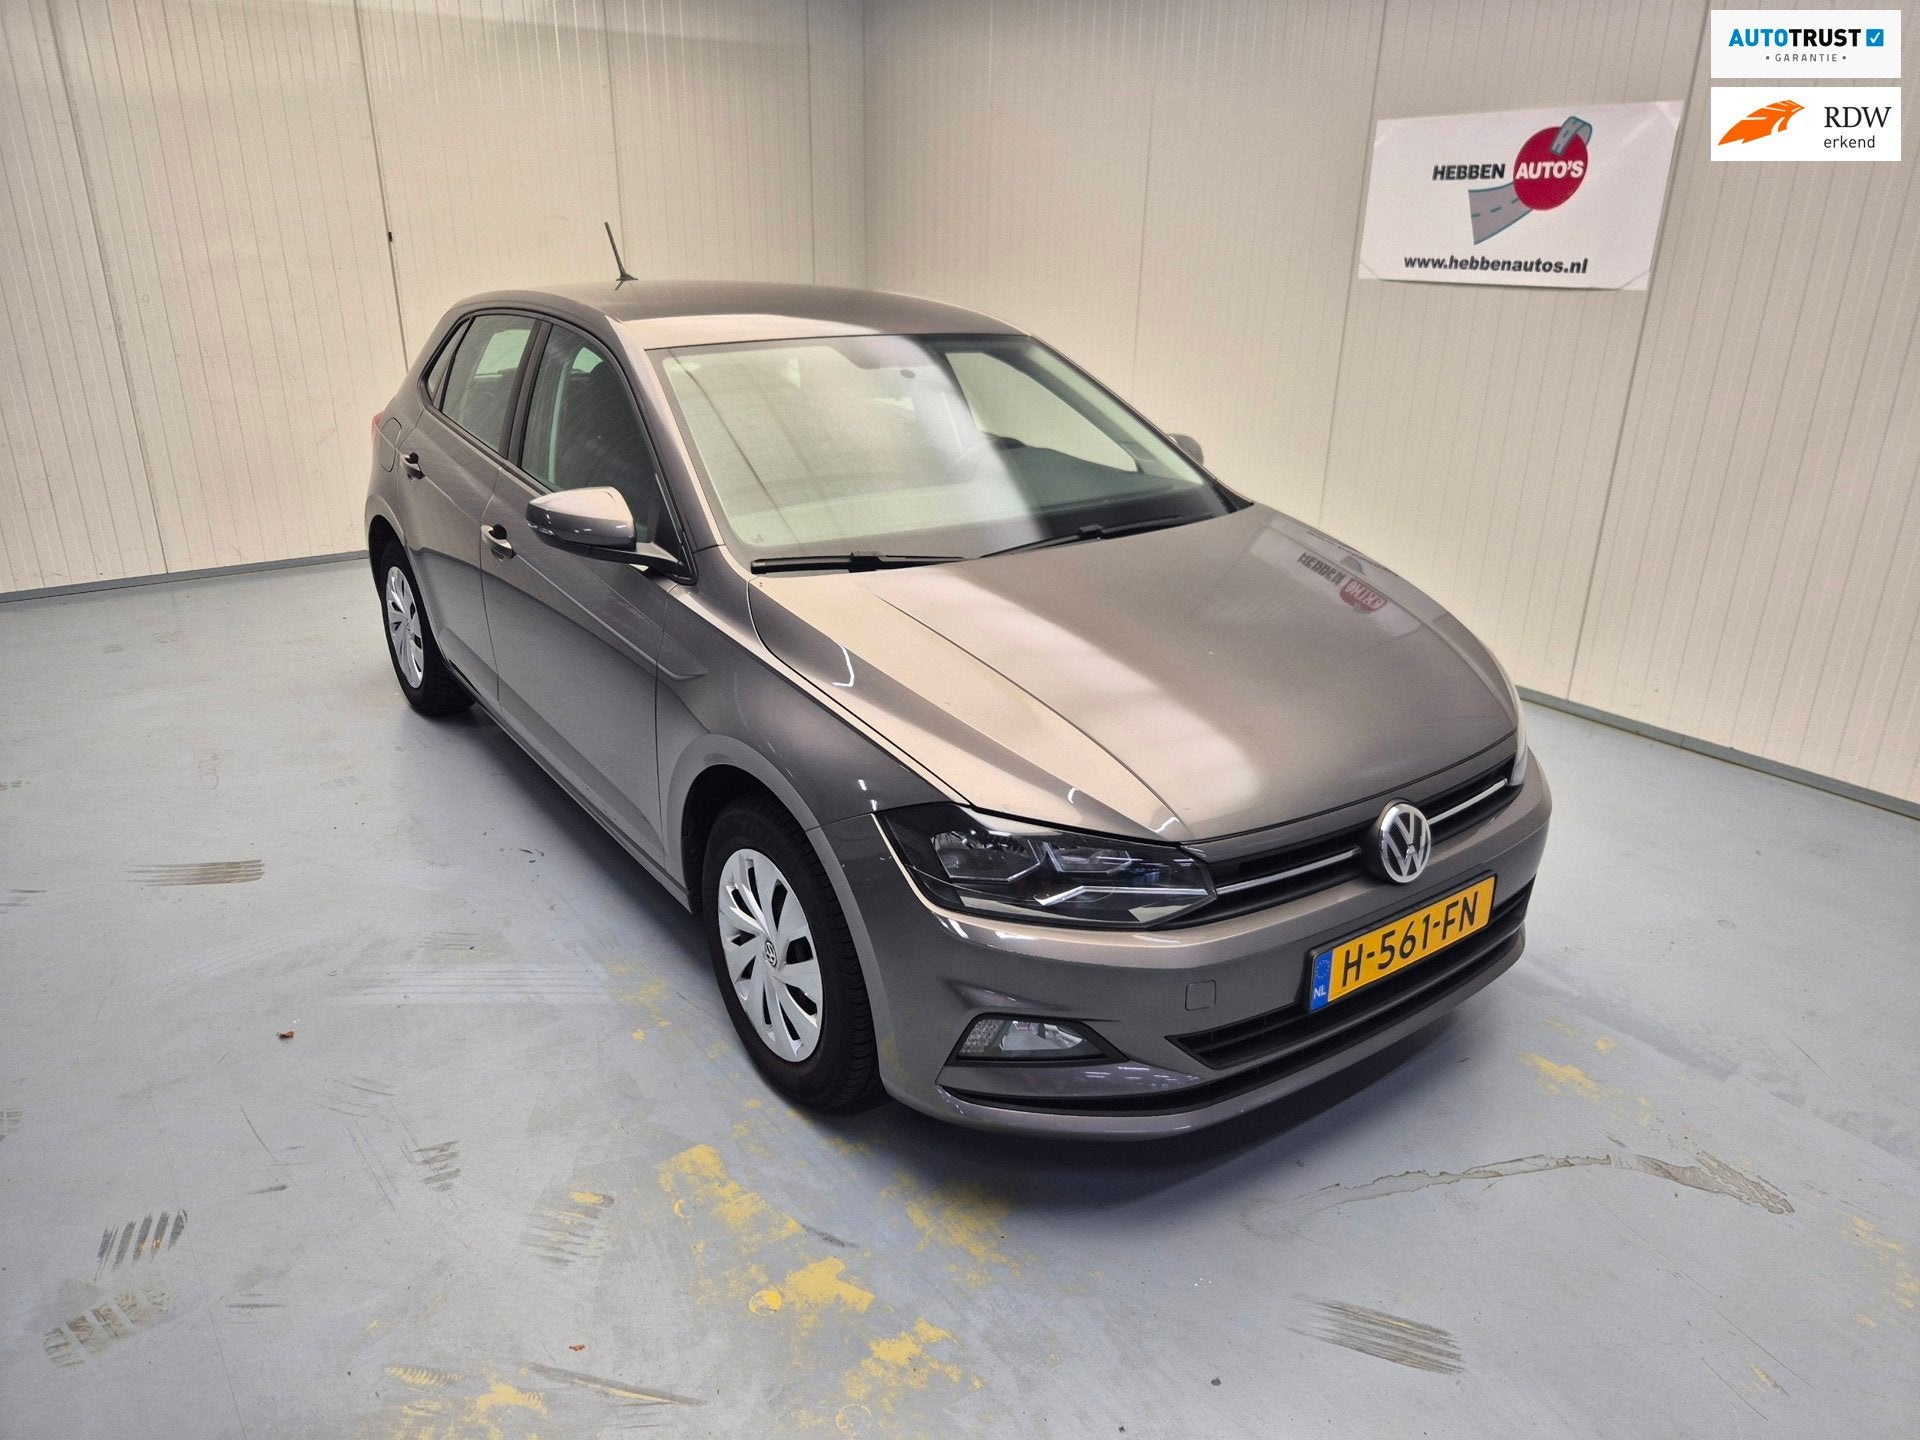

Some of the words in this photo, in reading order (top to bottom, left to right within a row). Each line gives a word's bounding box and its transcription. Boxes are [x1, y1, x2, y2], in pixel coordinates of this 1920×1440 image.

[1432, 163, 1506, 181] HEBBEN
[1514, 159, 1585, 180] AUTO'S
[1404, 255, 1588, 274] www.hebbenautos.nl
[1342, 891, 1479, 988] H-561-FN
[1313, 986, 1327, 999] NL
